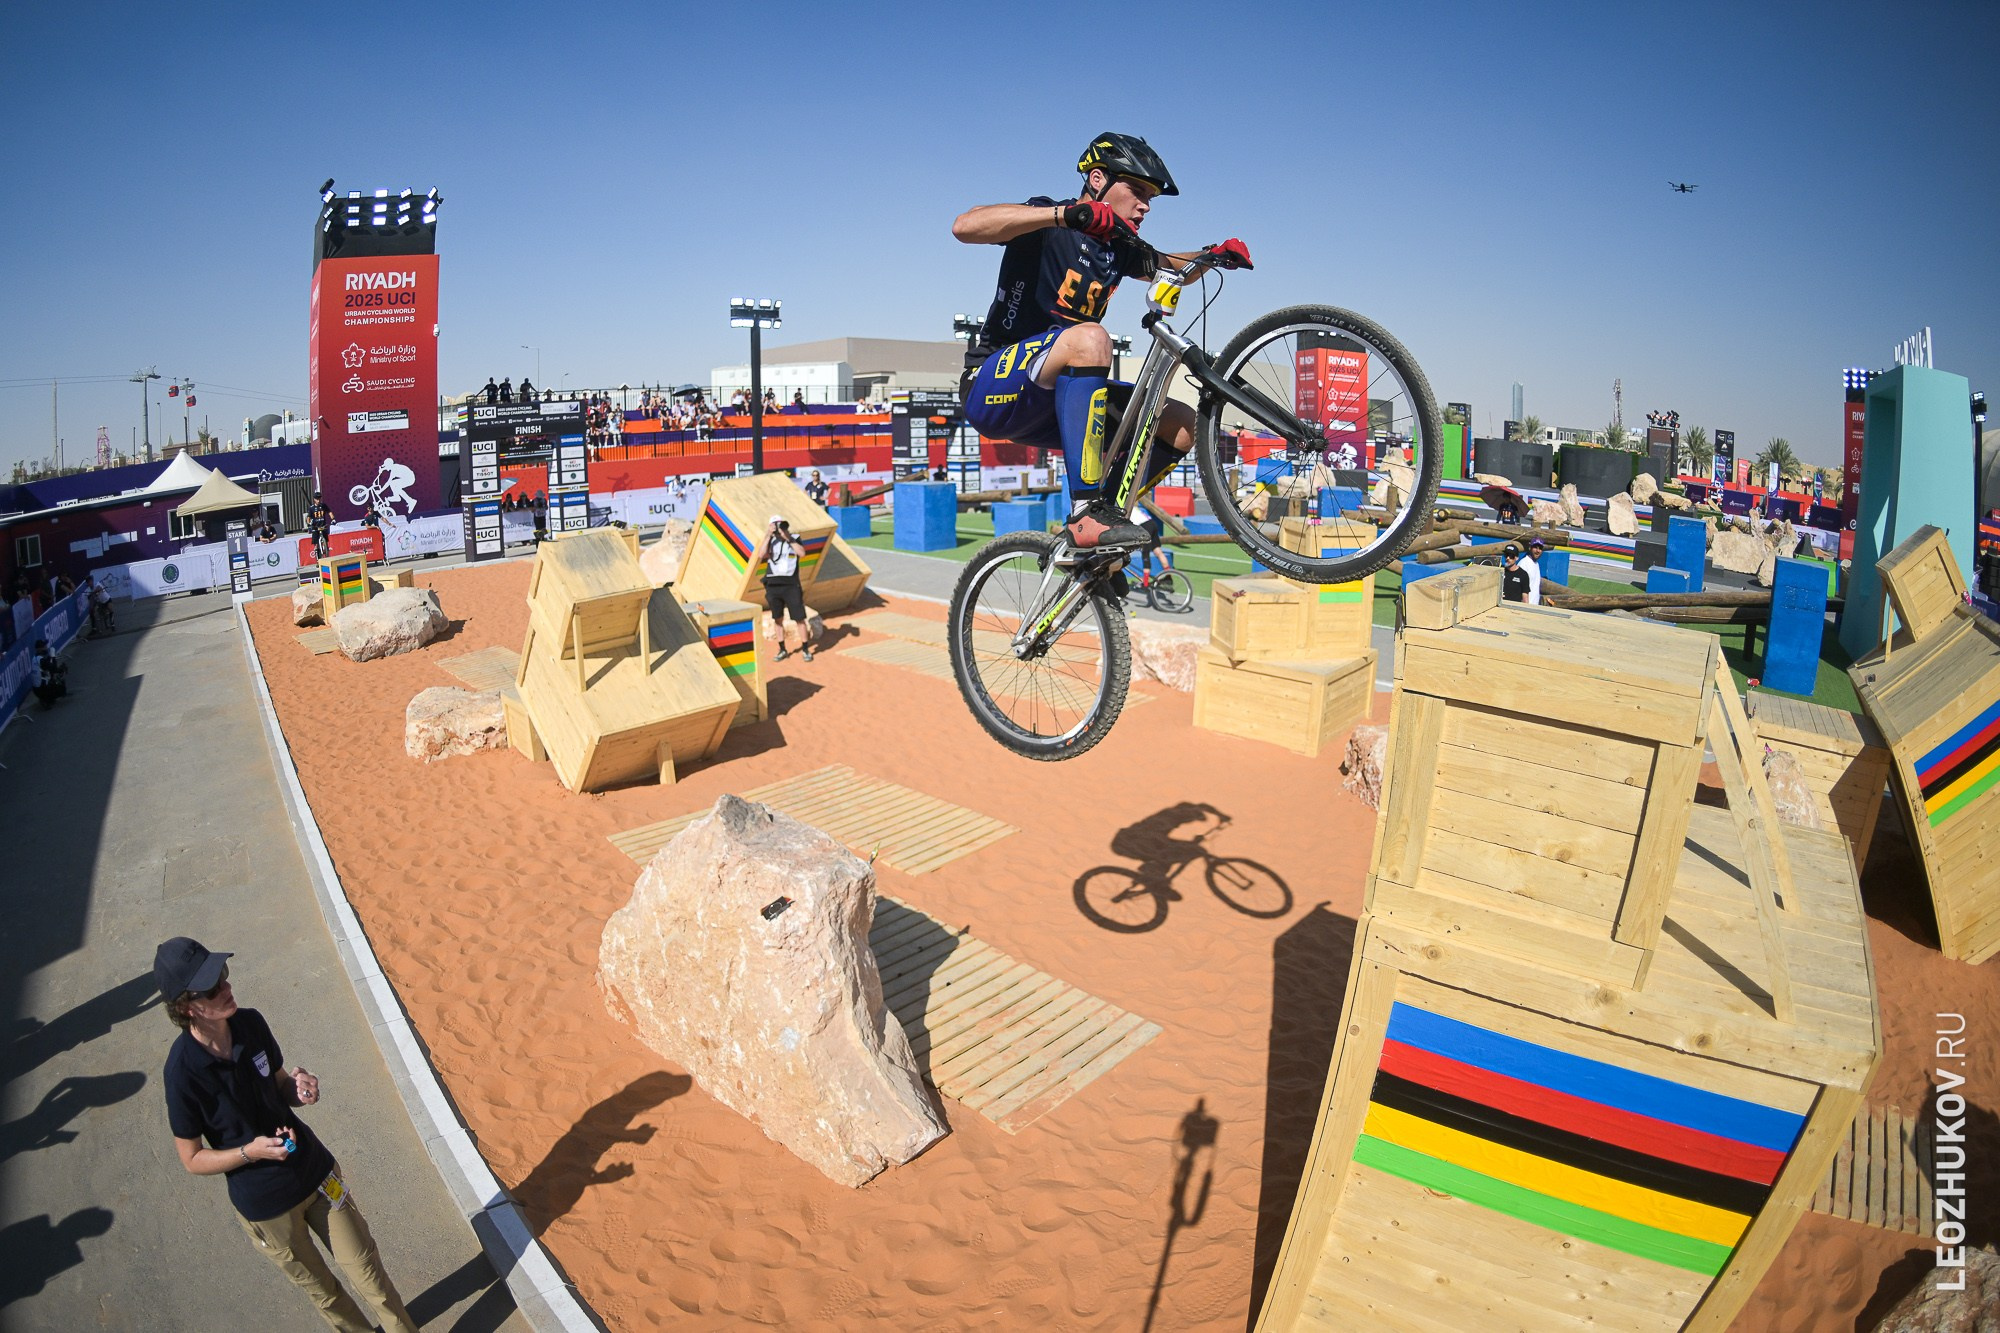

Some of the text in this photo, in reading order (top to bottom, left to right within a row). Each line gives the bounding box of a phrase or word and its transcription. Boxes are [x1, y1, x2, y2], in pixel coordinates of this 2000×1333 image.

[346, 272, 416, 290] RIYADH
[345, 292, 416, 307] 2025 UCI
[1003, 280, 1025, 330] Cofidis
[344, 316, 415, 326] CHAMPIONSHIPS
[1324, 316, 1345, 327] THE
[1347, 324, 1397, 361] NATIONAL
[370, 355, 391, 364] Ministry
[399, 354, 416, 363] Sport
[1328, 355, 1360, 367] RIYADH
[351, 413, 367, 422] UCI
[477, 408, 495, 417] UCI
[515, 425, 542, 435] FINISH
[477, 443, 494, 451] UCI
[654, 503, 675, 514] UCI
[568, 519, 585, 528] UCI
[228, 530, 246, 538] START
[480, 530, 498, 539] UCI
[234, 538, 241, 552] 1
[350, 536, 373, 546] RIYADH
